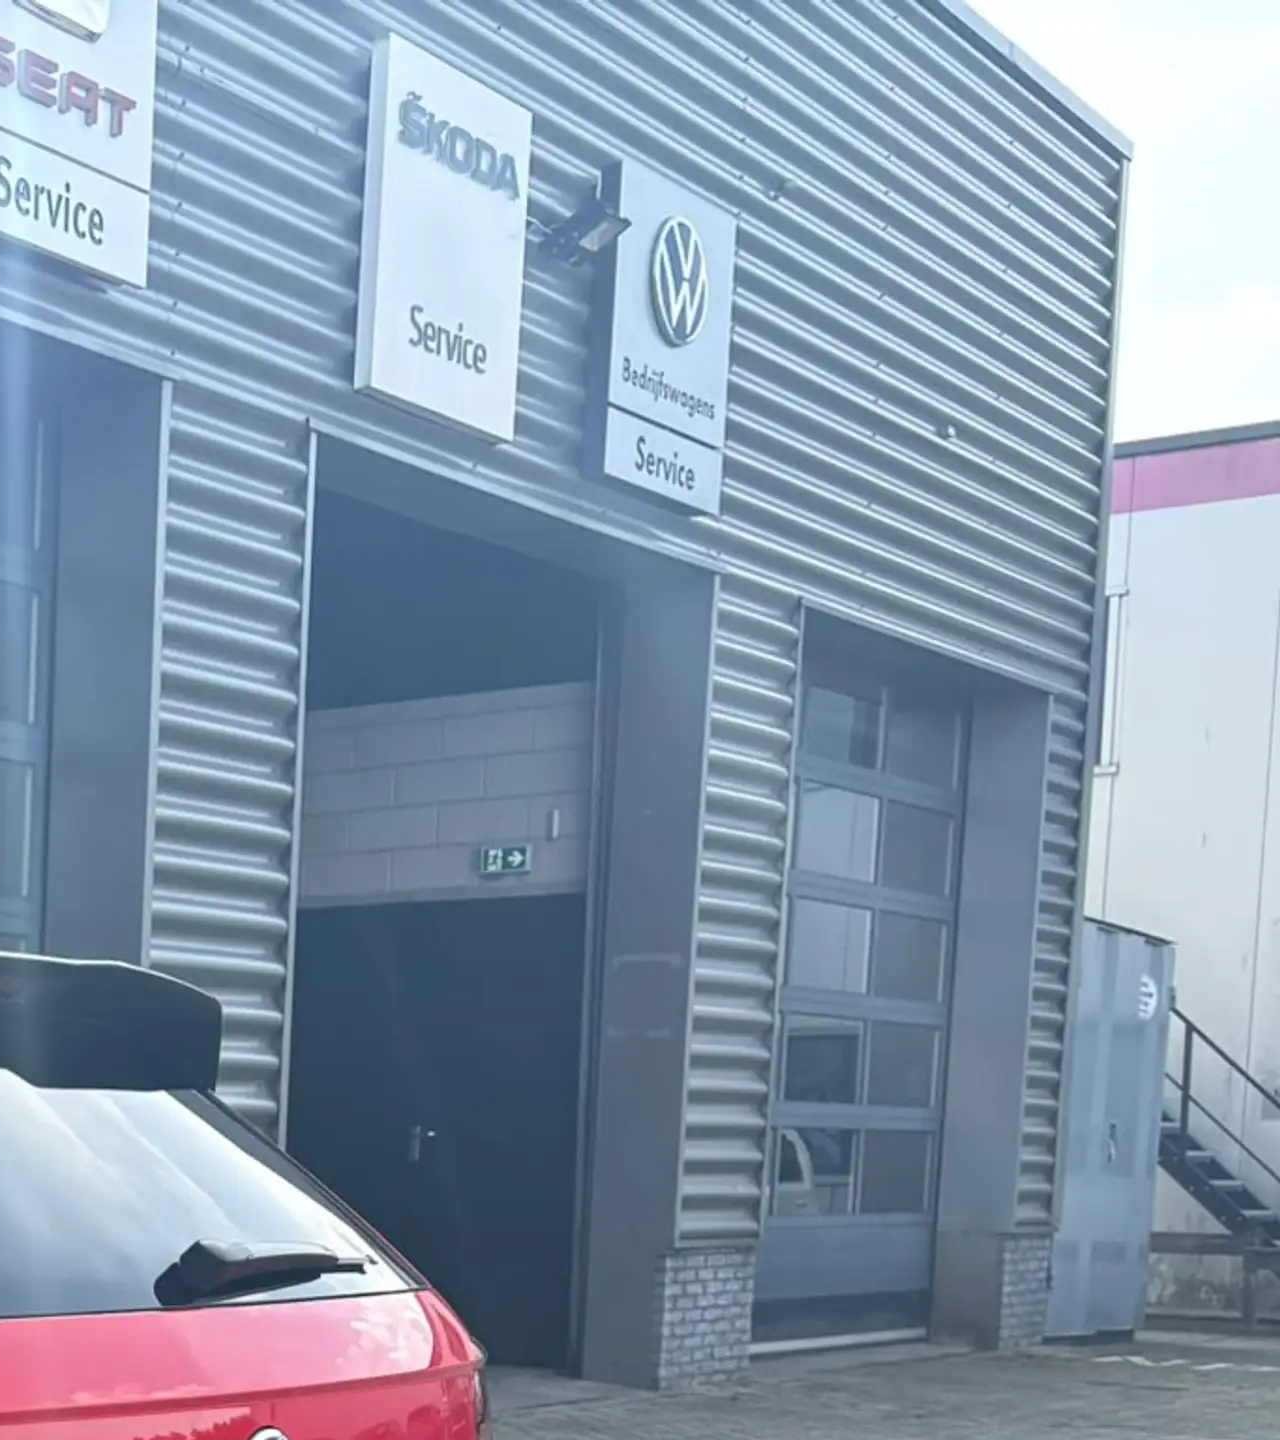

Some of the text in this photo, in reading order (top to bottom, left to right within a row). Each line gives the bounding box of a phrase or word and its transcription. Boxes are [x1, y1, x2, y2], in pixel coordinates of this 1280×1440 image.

[408, 304, 488, 374] Service
[622, 356, 715, 420] Bedrijfswagens
[634, 435, 695, 491] Service
